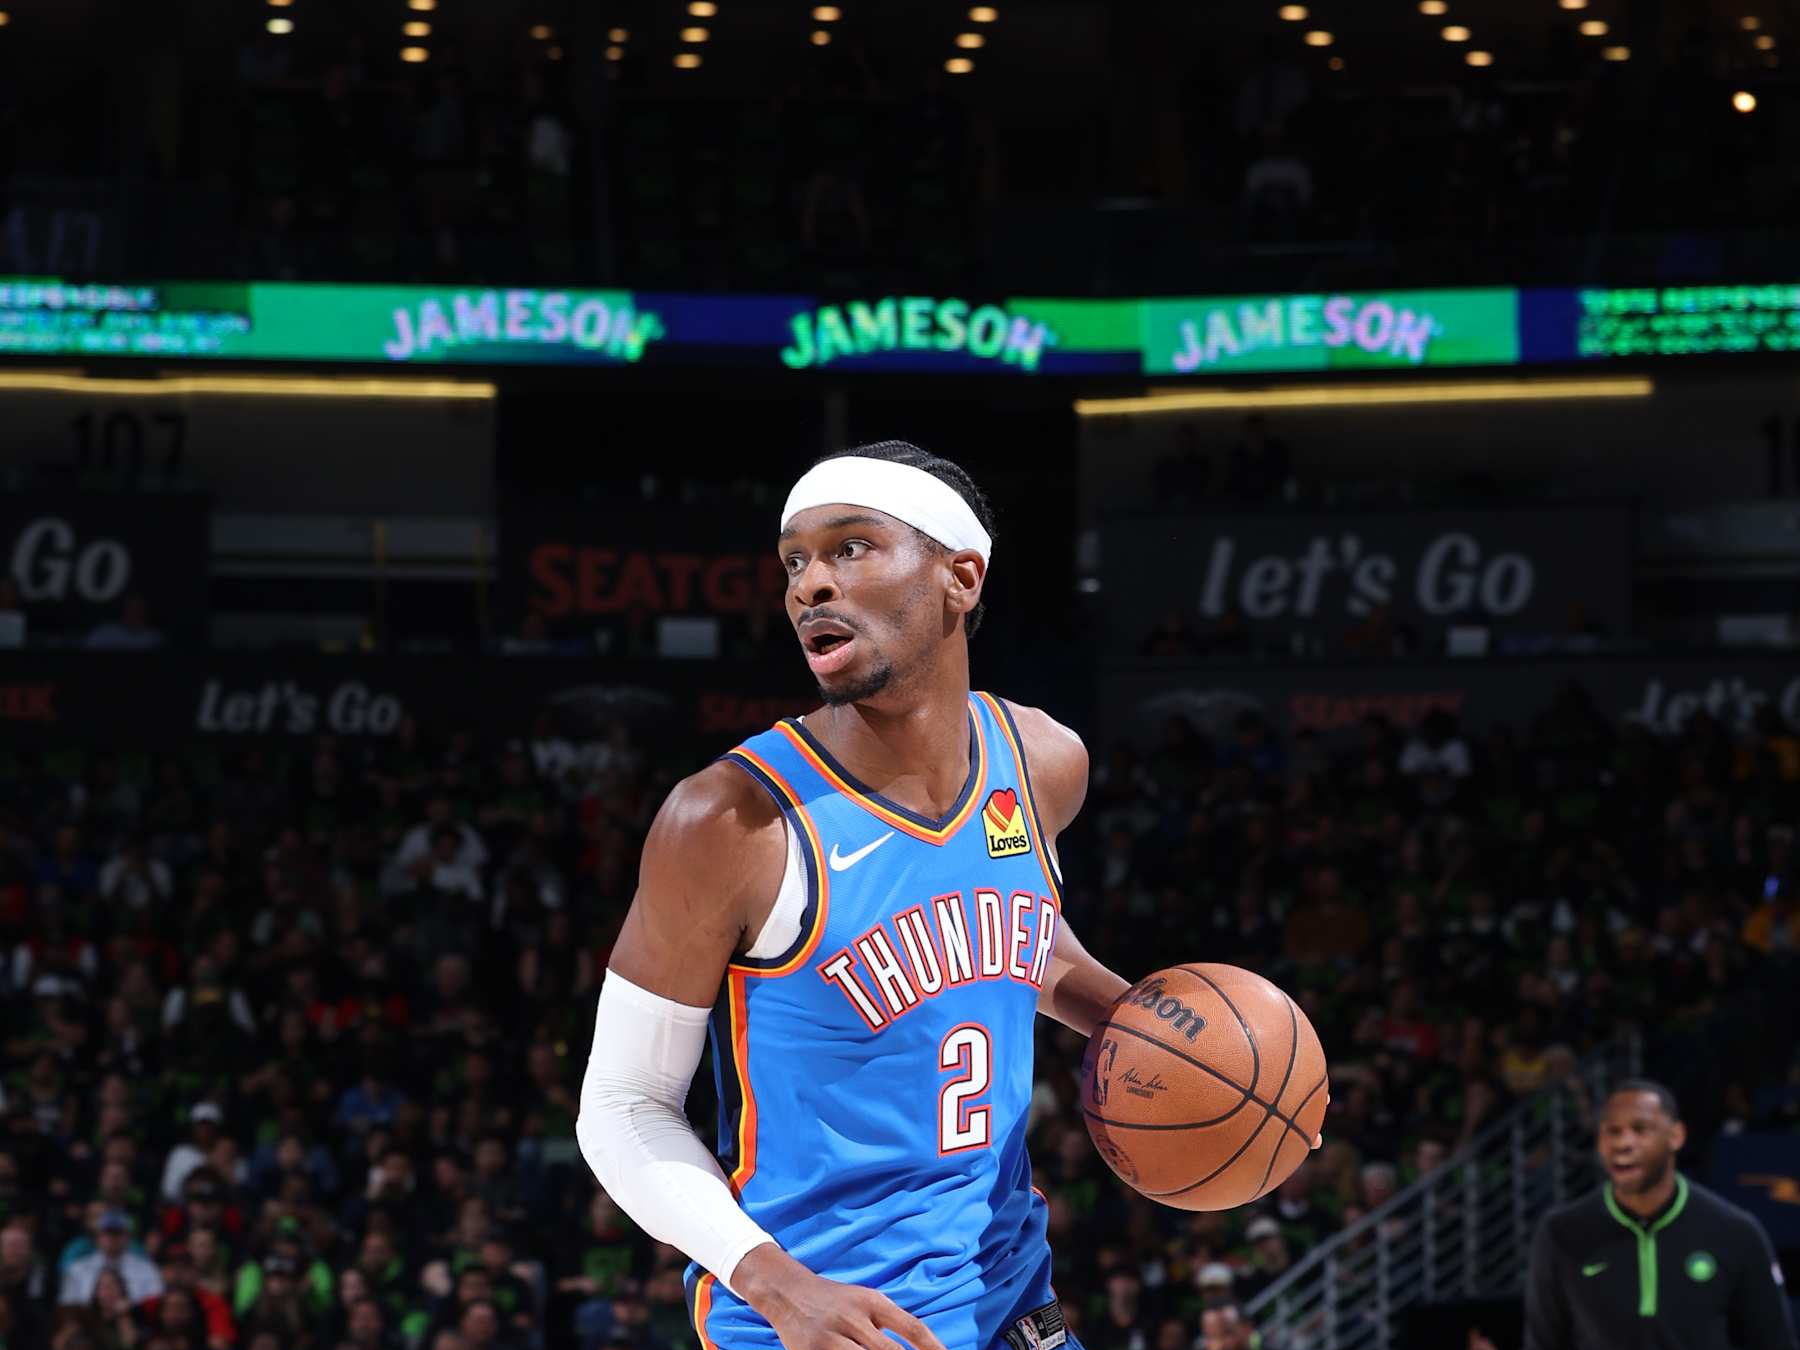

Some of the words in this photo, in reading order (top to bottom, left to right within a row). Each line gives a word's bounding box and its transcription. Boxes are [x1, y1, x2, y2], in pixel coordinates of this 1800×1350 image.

[384, 288, 662, 361] JAMESON
[781, 297, 1056, 370] JAMESON
[1171, 297, 1441, 371] JAMESON
[11, 517, 131, 602] Go
[1415, 532, 1535, 617] Go
[196, 678, 319, 734] Let's
[327, 681, 401, 735] Go
[816, 887, 1059, 1033] THUNDER
[938, 1022, 992, 1157] 2
